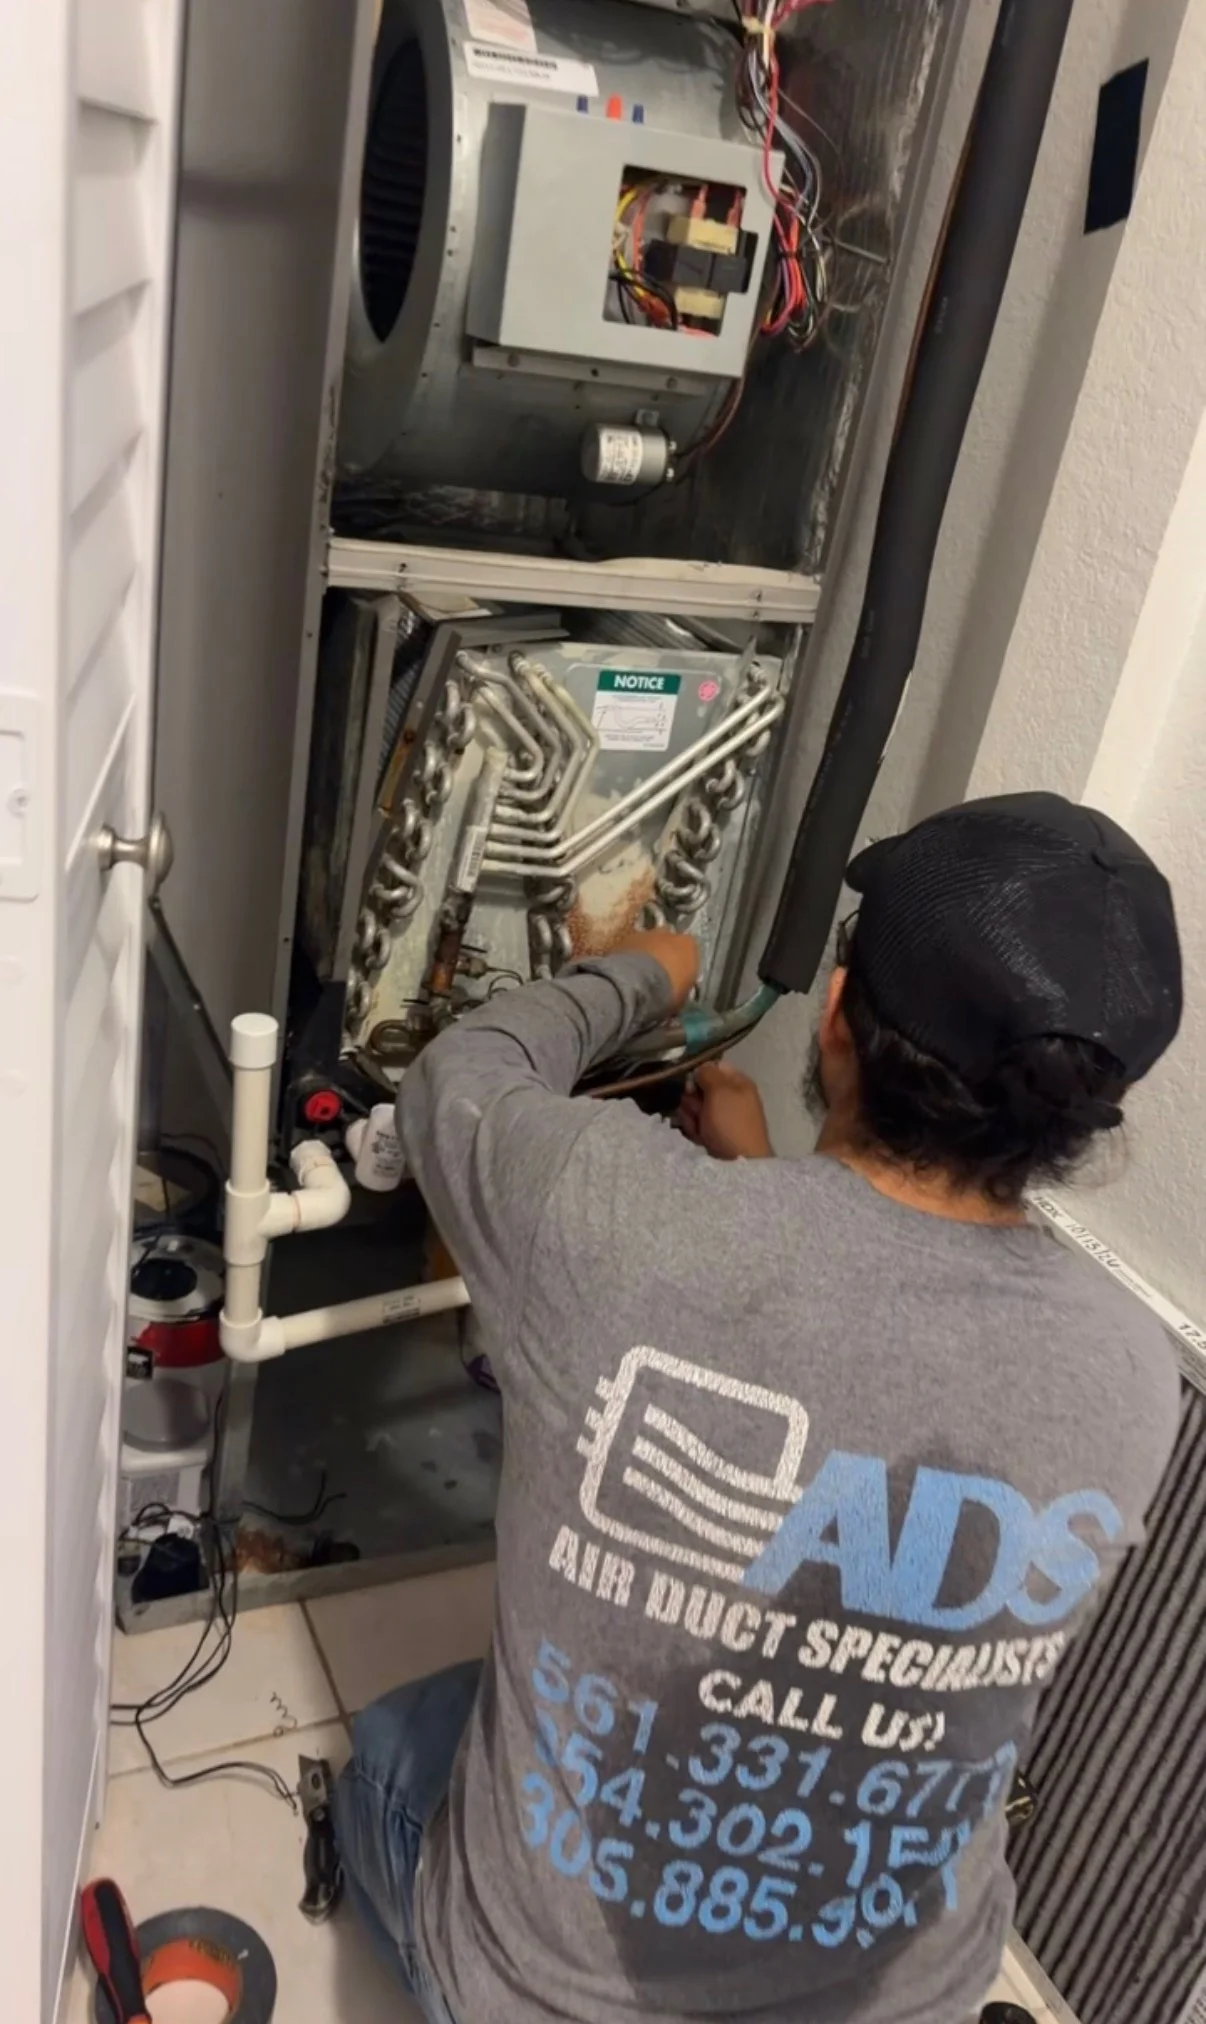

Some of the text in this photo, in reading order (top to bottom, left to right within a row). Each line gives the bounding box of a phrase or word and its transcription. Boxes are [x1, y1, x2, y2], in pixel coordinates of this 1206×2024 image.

[613, 674, 665, 690] NOTICE
[741, 1449, 1123, 1630] ADS
[549, 1525, 1066, 1692] AIR DUCT SPECIALISTS
[698, 1669, 945, 1751] CALL US!
